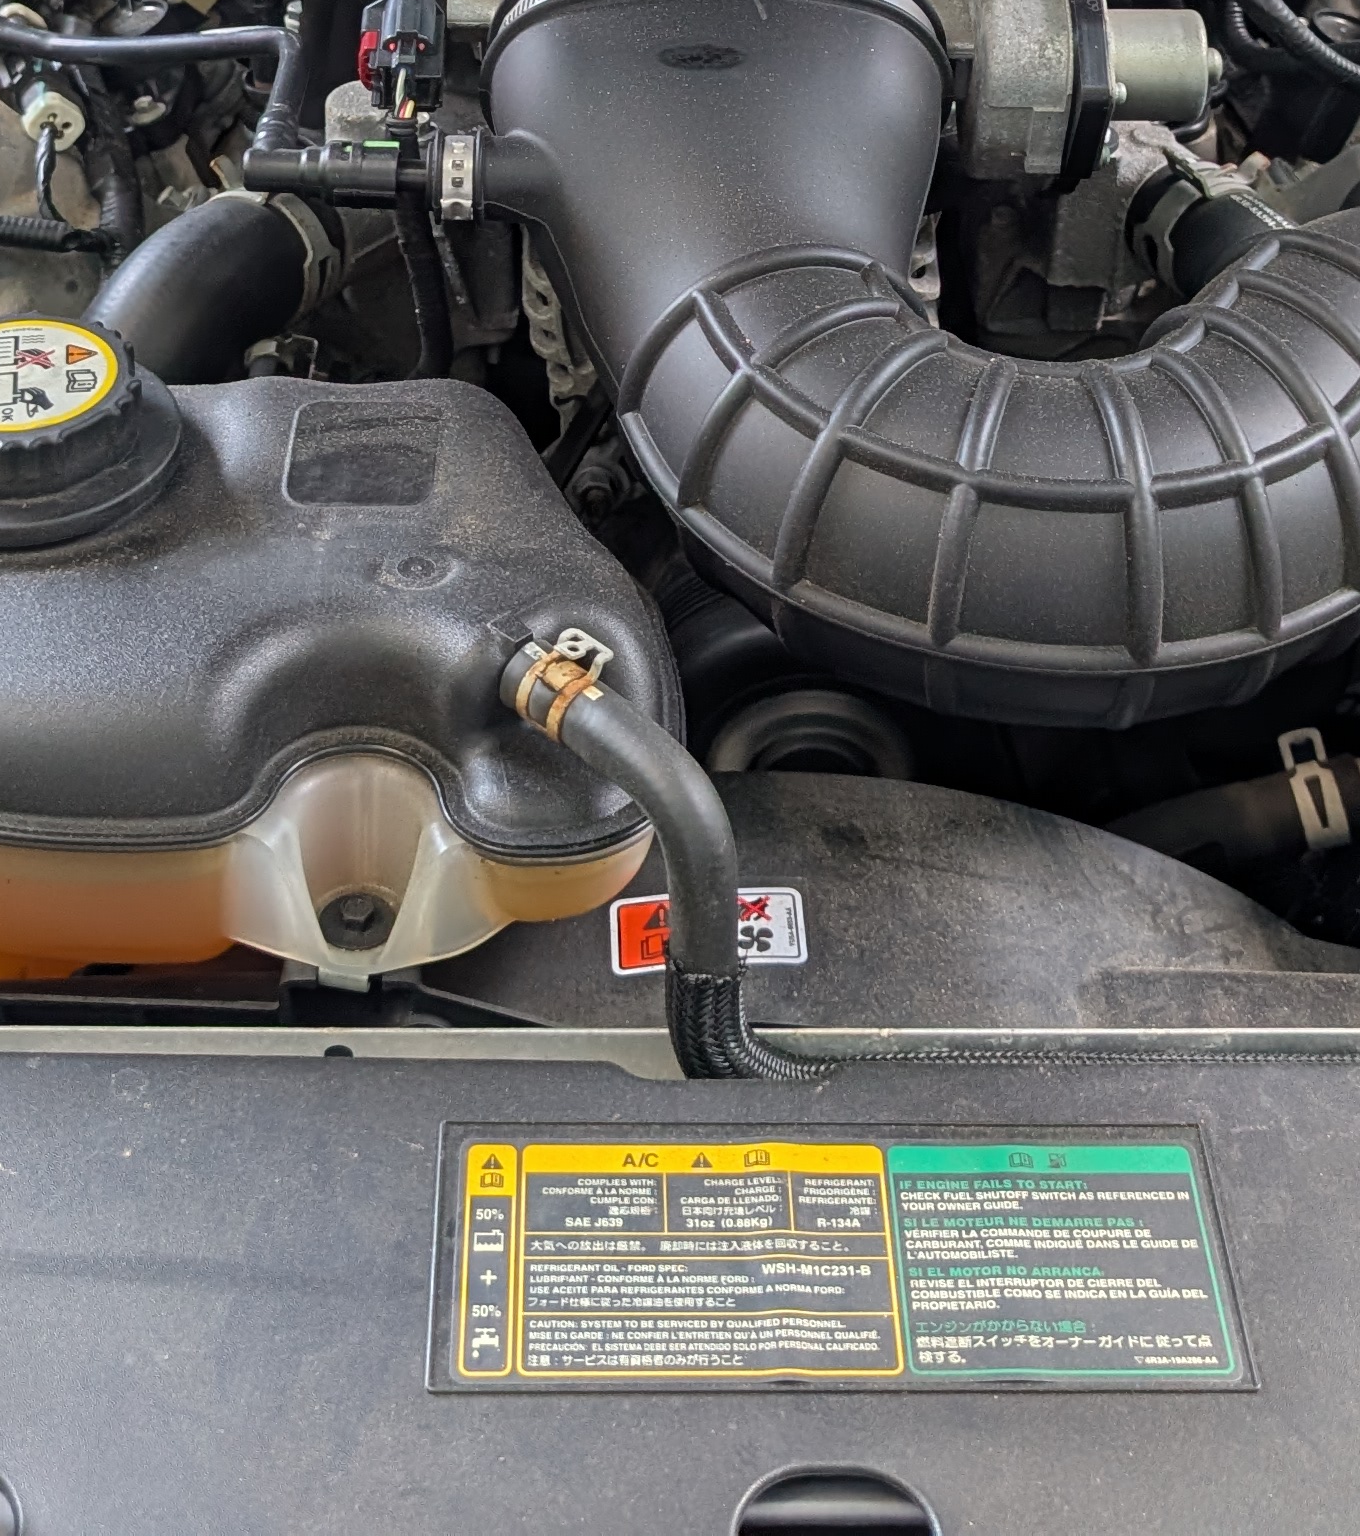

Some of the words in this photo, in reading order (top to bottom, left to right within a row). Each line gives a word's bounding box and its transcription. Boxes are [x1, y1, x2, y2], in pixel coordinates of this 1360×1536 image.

[1, 408, 14, 423] OK
[623, 1153, 659, 1168] A/C
[900, 1181, 912, 1189] IF
[917, 1180, 968, 1189] ENGINE
[974, 1179, 1012, 1189] FAILS
[1017, 1180, 1035, 1189] TO
[735, 1187, 775, 1195] CHARGE
[901, 1192, 941, 1200] CHECK
[944, 1192, 974, 1200] FUEL
[976, 1191, 1029, 1200] SHUTOFF
[1032, 1192, 1076, 1200] SWITCH
[1078, 1192, 1094, 1200] AS
[1098, 1192, 1175, 1200] REFERENCED
[1178, 1192, 1189, 1200] IN
[680, 1197, 714, 1205] CARGA
[902, 1202, 934, 1210] YOUR
[937, 1202, 981, 1210] OWNER
[984, 1201, 1023, 1209] GUIDE.
[476, 1209, 504, 1220] 50%
[565, 1218, 591, 1227] SAE
[594, 1218, 623, 1227] J639
[686, 1218, 715, 1227] 31oz
[817, 1218, 860, 1227] R-134A
[904, 1218, 917, 1227] SI
[922, 1218, 938, 1226] LE
[944, 1217, 1004, 1227] MOTEUR
[1008, 1217, 1027, 1226] NE
[1107, 1218, 1134, 1226] PAS
[962, 1230, 978, 1238] LA
[981, 1229, 1051, 1237] COMMANDE
[1073, 1229, 1132, 1237] COUPURE
[1135, 1229, 1151, 1237] DE
[986, 1239, 1031, 1248] COMME
[1087, 1240, 1120, 1248] DANS
[1123, 1240, 1138, 1248] LE
[1141, 1240, 1179, 1248] GUIDE
[1182, 1239, 1198, 1248] DE
[628, 1264, 655, 1272] FORD
[762, 1263, 871, 1276] WSH-M1C231-B
[908, 1268, 922, 1276] SI
[927, 1267, 945, 1276] EL
[950, 1267, 1002, 1276] MOTOR
[1007, 1266, 1027, 1275] NO
[598, 1275, 654, 1283] CONFORME
[910, 1279, 954, 1288] REVISE
[958, 1279, 974, 1287] EL
[976, 1278, 1064, 1288] INTERRUPTOR
[1067, 1279, 1084, 1287] DE
[1087, 1279, 1133, 1287] CIERRE
[1136, 1279, 1162, 1287] DEL
[707, 1286, 763, 1294] CONFORME
[775, 1284, 812, 1293] NORMA
[911, 1289, 1001, 1298] COMBUSTIBLE
[1004, 1289, 1042, 1298] COMO
[1045, 1289, 1062, 1298] SE
[1065, 1290, 1107, 1298] INDICA
[1110, 1290, 1127, 1298] EN
[1130, 1290, 1147, 1298] LA
[1183, 1289, 1208, 1298] DEL
[913, 1301, 1000, 1310] PROPIETARIO.
[472, 1305, 501, 1317] 50%
[581, 1320, 621, 1328] SYSTEM
[625, 1320, 638, 1328] TO
[641, 1320, 654, 1328] BE
[657, 1320, 708, 1328] SERVICED
[727, 1319, 780, 1328] QUALIFIED
[570, 1332, 603, 1340] GARDE
[627, 1332, 669, 1340] CONFIER
[775, 1330, 832, 1339] PERSONNEL
